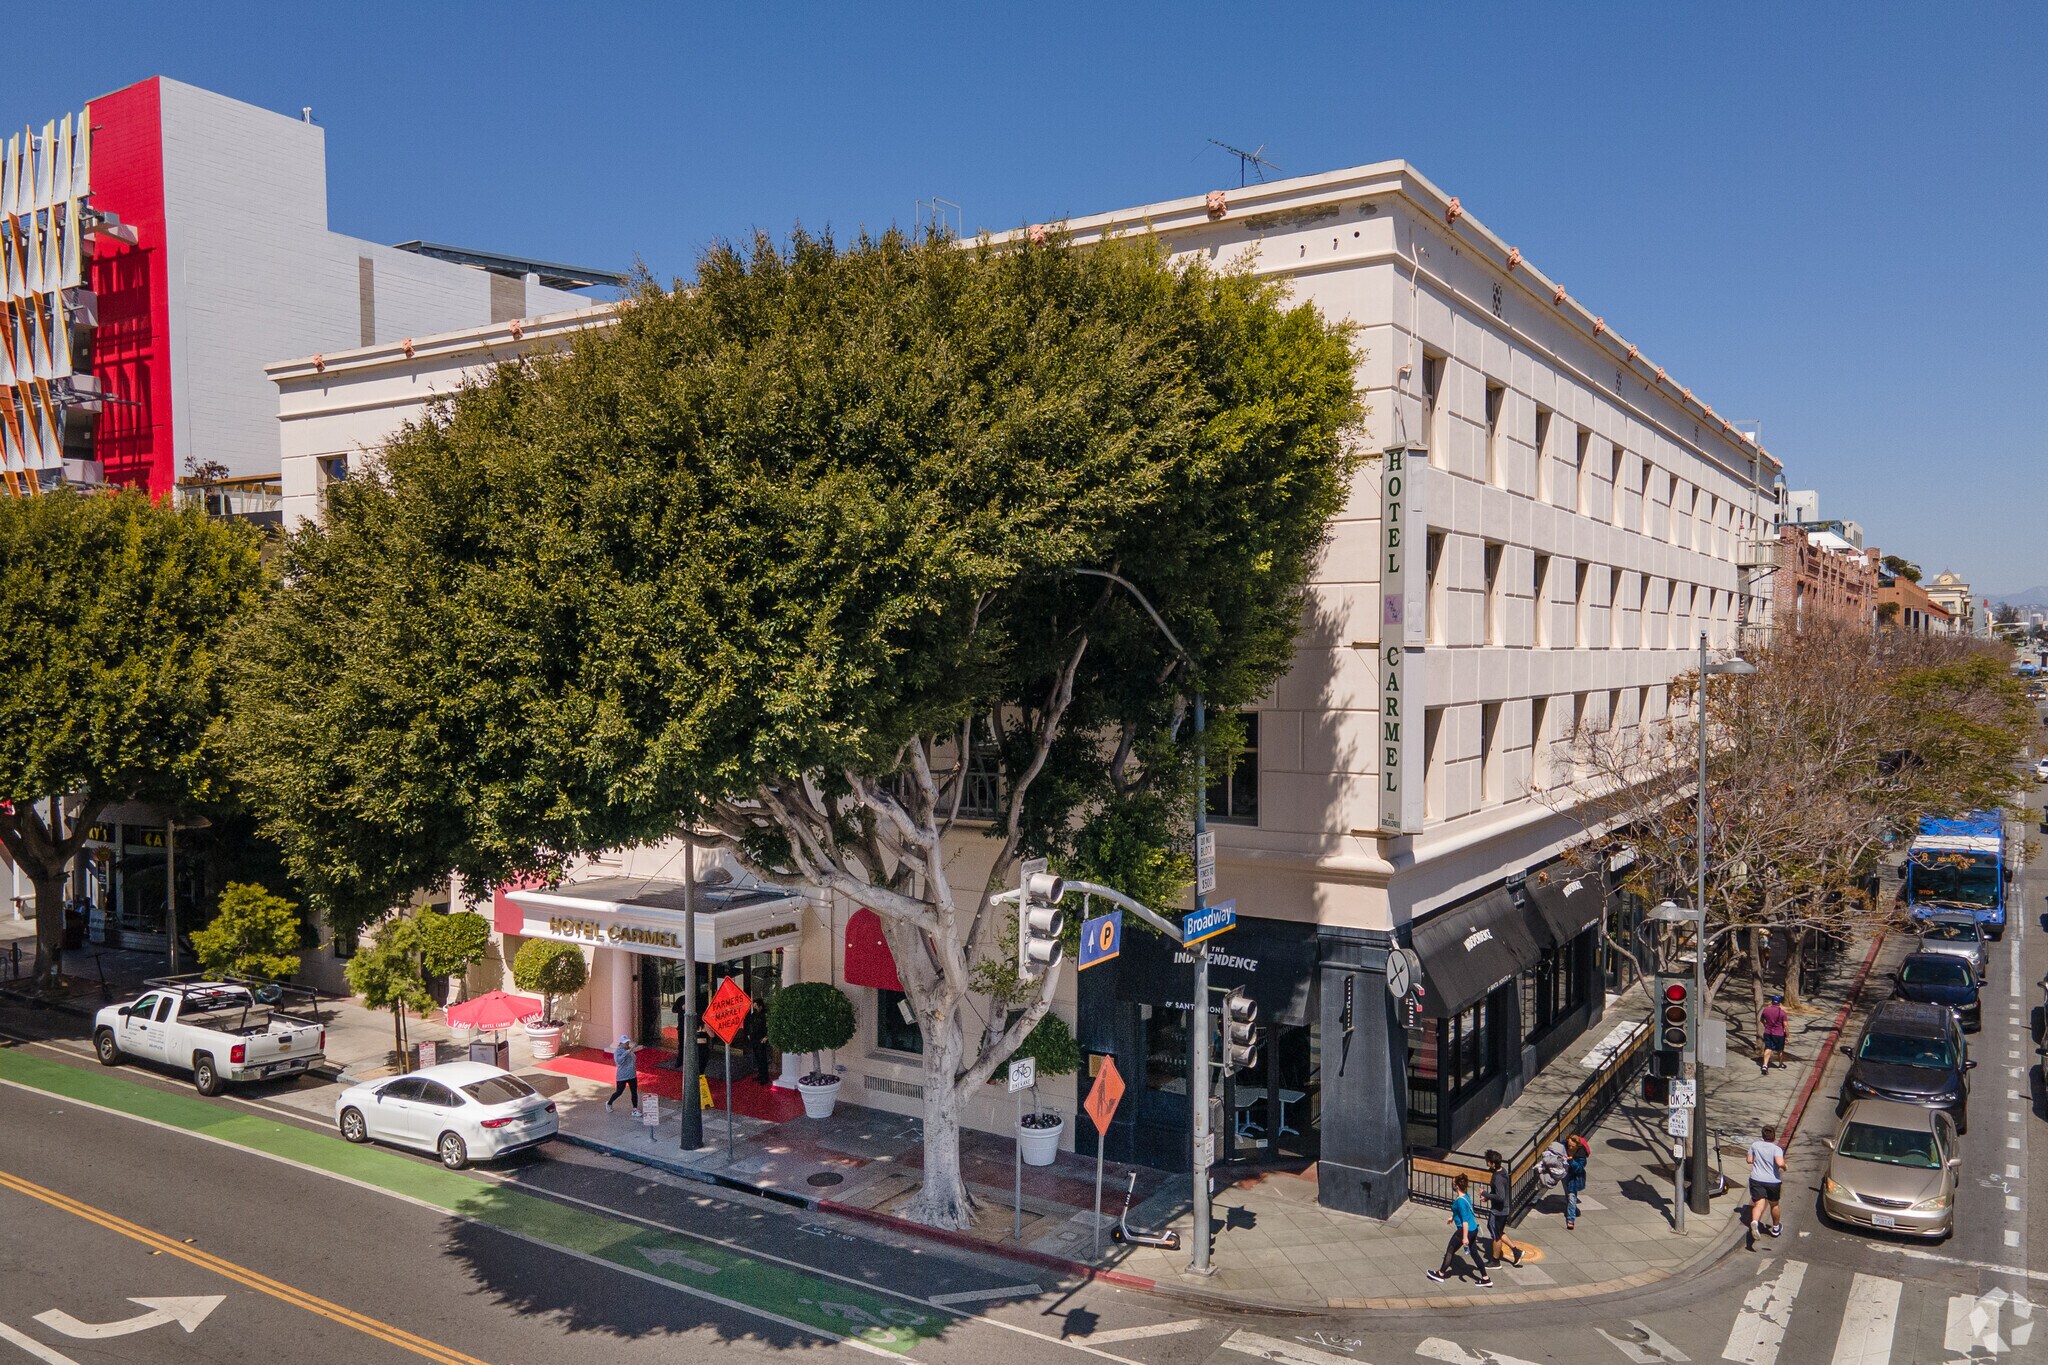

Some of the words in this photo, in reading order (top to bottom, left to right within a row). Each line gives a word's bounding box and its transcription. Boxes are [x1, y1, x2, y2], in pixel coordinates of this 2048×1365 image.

[1388, 452, 1402, 573] HOTEL
[1384, 646, 1400, 792] CARMEL
[1187, 907, 1232, 935] Broadway
[550, 917, 604, 942] HOTEL
[608, 923, 682, 948] CARMEL
[722, 933, 758, 948] HOTEL
[758, 922, 799, 939] CARMEL
[713, 994, 744, 1010] FARMERS
[1175, 1001, 1195, 1010] SANT
[521, 1012, 540, 1024] Valet
[716, 1008, 740, 1020] MARKET
[452, 1020, 472, 1029] Valet
[718, 1017, 740, 1029] AHEAD
[1671, 1095, 1680, 1105] OK
